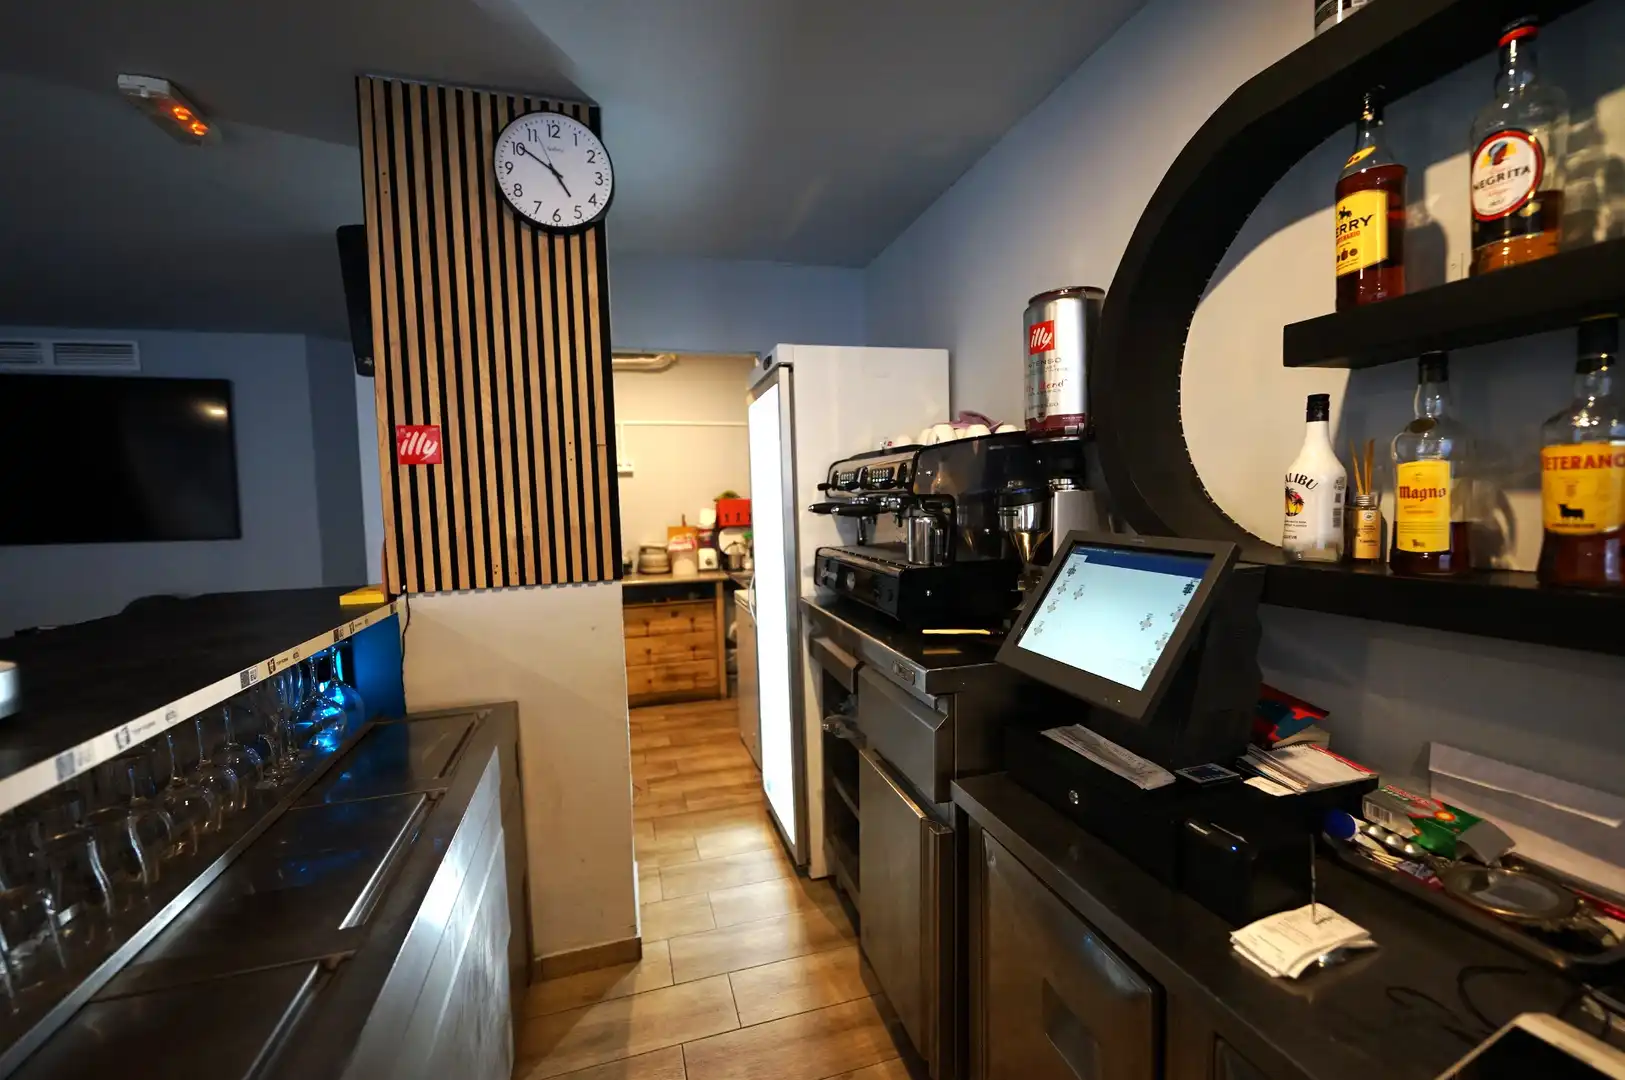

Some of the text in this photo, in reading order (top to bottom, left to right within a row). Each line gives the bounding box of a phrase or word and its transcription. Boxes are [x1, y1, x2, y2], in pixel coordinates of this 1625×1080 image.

[527, 128, 538, 142] 11
[547, 124, 561, 139] 12
[573, 133, 579, 147] 1
[511, 141, 526, 156] 10
[586, 149, 596, 164] 2
[504, 161, 514, 175] 9
[594, 171, 604, 186] 3
[513, 183, 523, 197] 8
[533, 200, 543, 214] 7
[588, 193, 598, 207] 4
[552, 208, 562, 222] 6
[573, 205, 583, 219] 5
[1031, 327, 1052, 350] illy
[400, 430, 438, 461] illy
[1399, 485, 1446, 502] Magno
